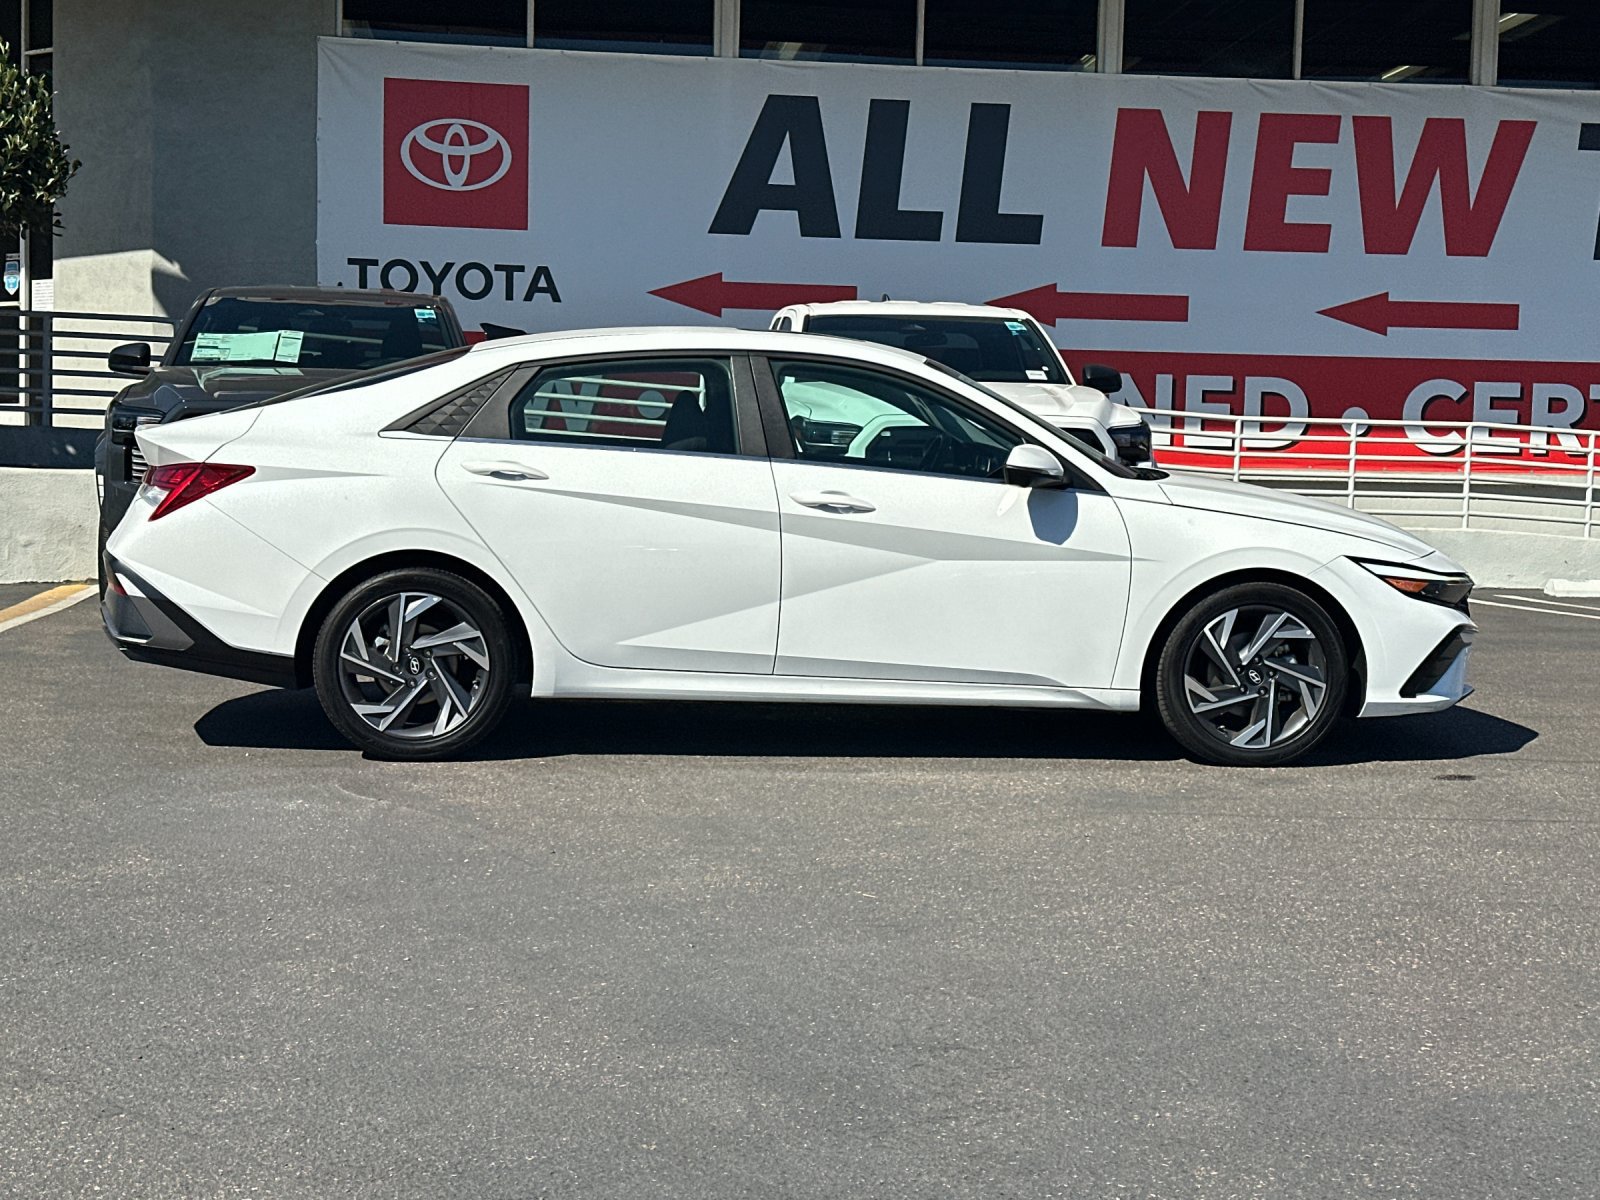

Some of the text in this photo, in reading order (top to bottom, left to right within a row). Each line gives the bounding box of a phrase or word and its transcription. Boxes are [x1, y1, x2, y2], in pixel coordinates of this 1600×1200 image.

[708, 94, 1044, 245] ALL
[1101, 107, 1538, 257] NEW
[347, 258, 562, 303] TOYOTA
[1402, 378, 1600, 454] CER
